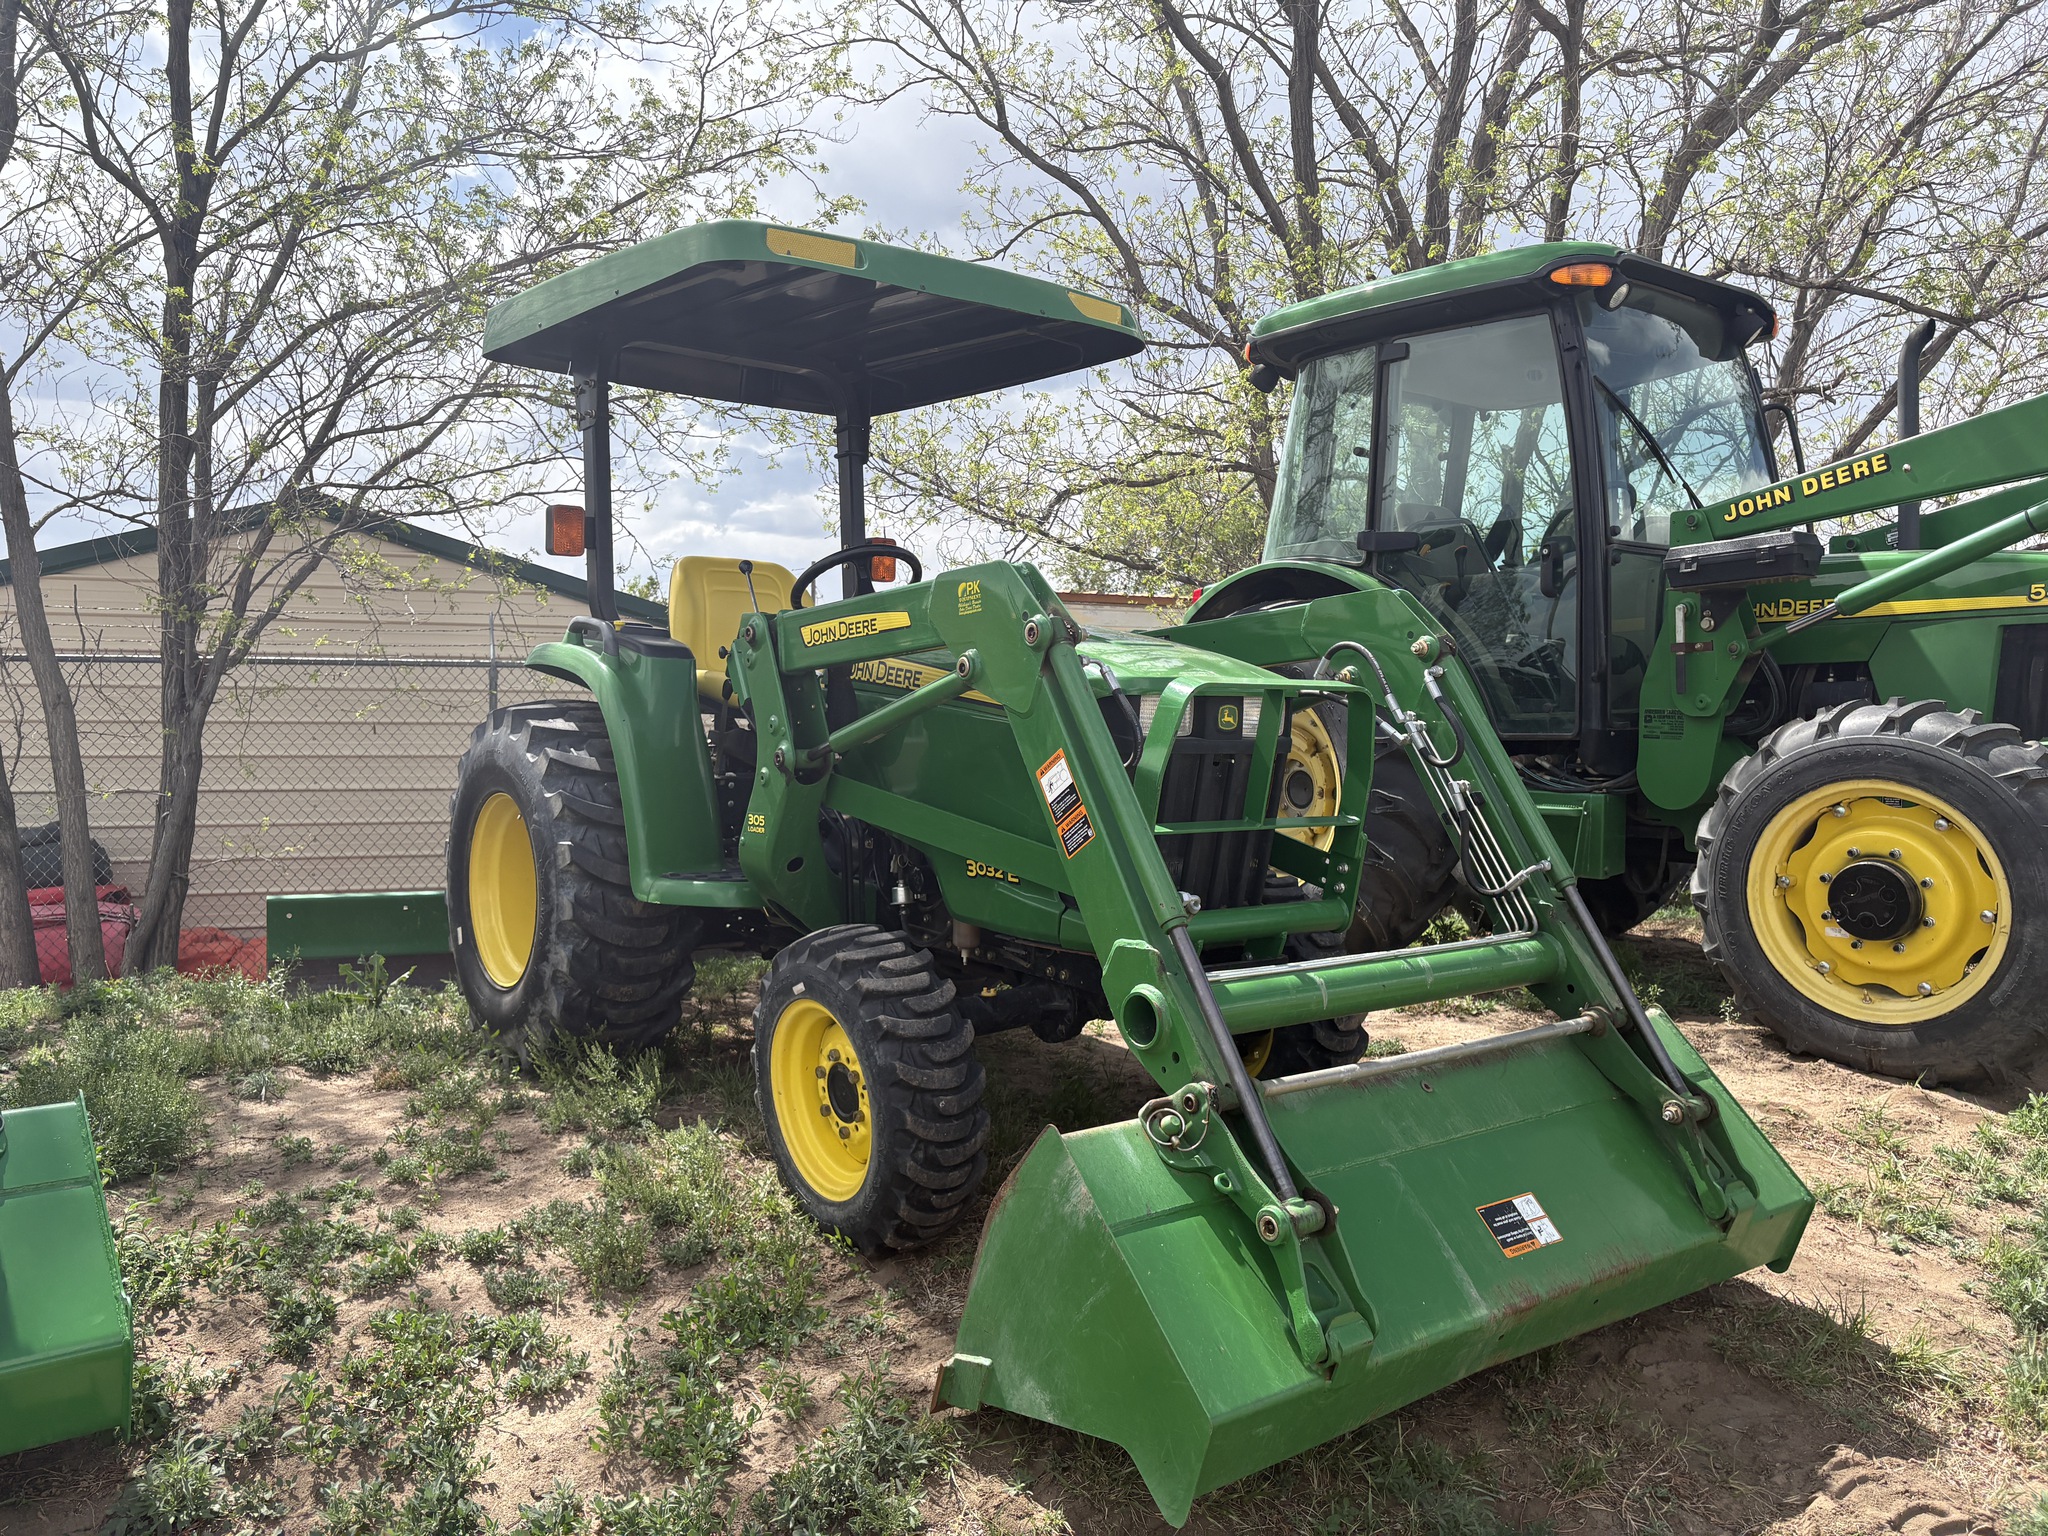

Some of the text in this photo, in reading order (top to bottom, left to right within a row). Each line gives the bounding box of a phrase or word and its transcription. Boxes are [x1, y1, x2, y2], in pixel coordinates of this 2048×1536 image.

[1723, 453, 1889, 523] JOHN DEERE
[2030, 583, 2048, 602] 5
[1753, 598, 1835, 617] HN DEE
[806, 617, 878, 645] JOHN DEERE
[875, 660, 923, 688] DEERE
[1043, 753, 1062, 772] WARNING
[747, 813, 765, 827] 305
[1065, 809, 1084, 828] WARNING
[747, 825, 765, 834] LOADER
[966, 859, 1004, 879] 3032
